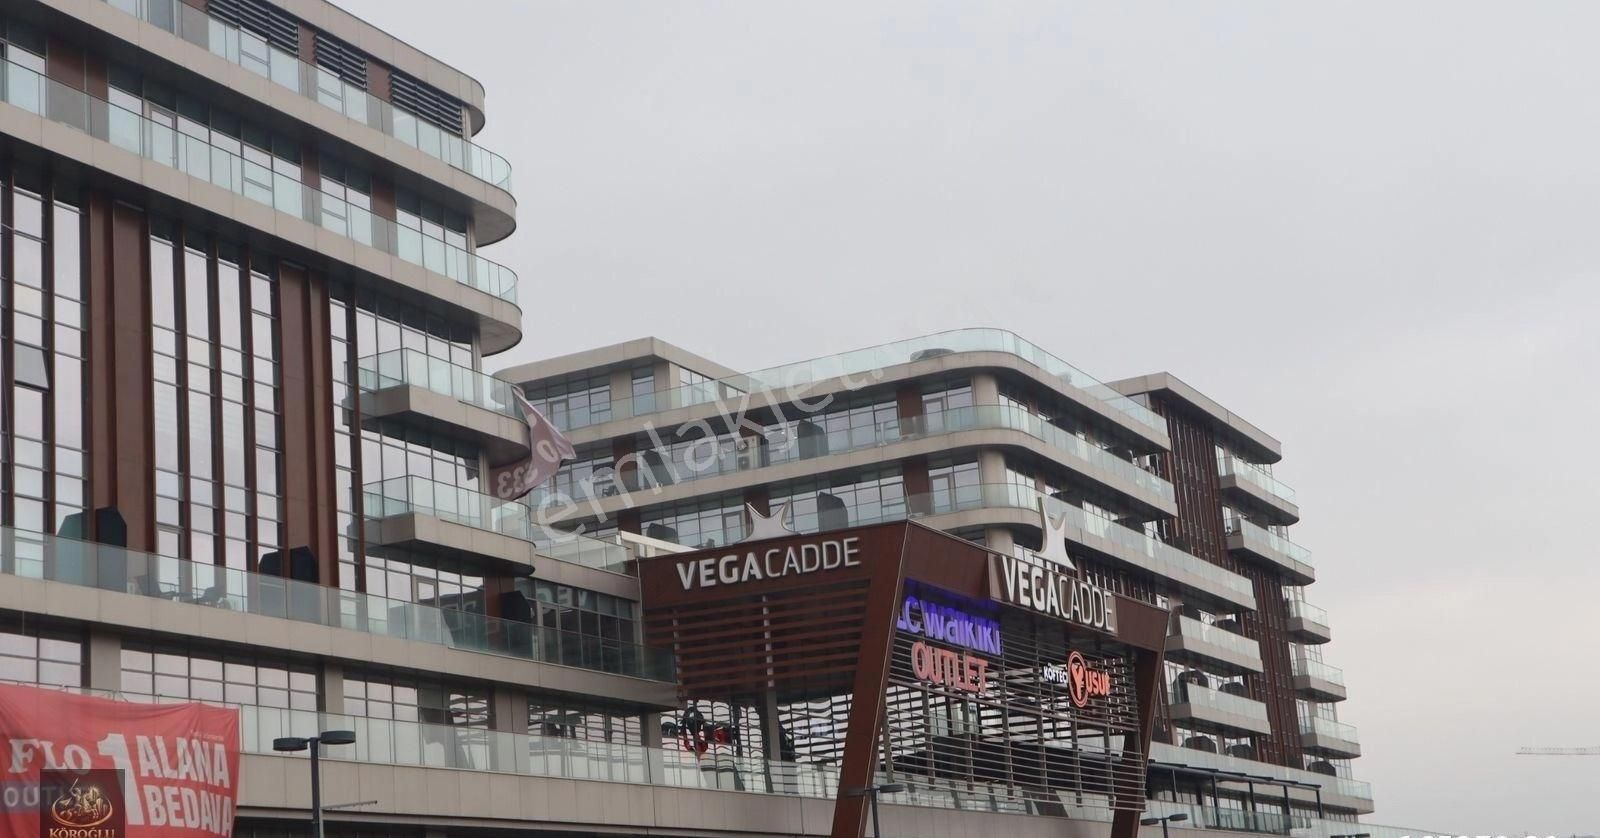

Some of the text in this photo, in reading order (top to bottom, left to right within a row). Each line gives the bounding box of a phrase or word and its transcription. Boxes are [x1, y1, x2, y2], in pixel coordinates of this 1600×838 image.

[911, 641, 988, 697] OUTLET
[97, 733, 144, 825] 1
[136, 735, 230, 788] ALANA
[143, 785, 231, 838] BEDAVA
